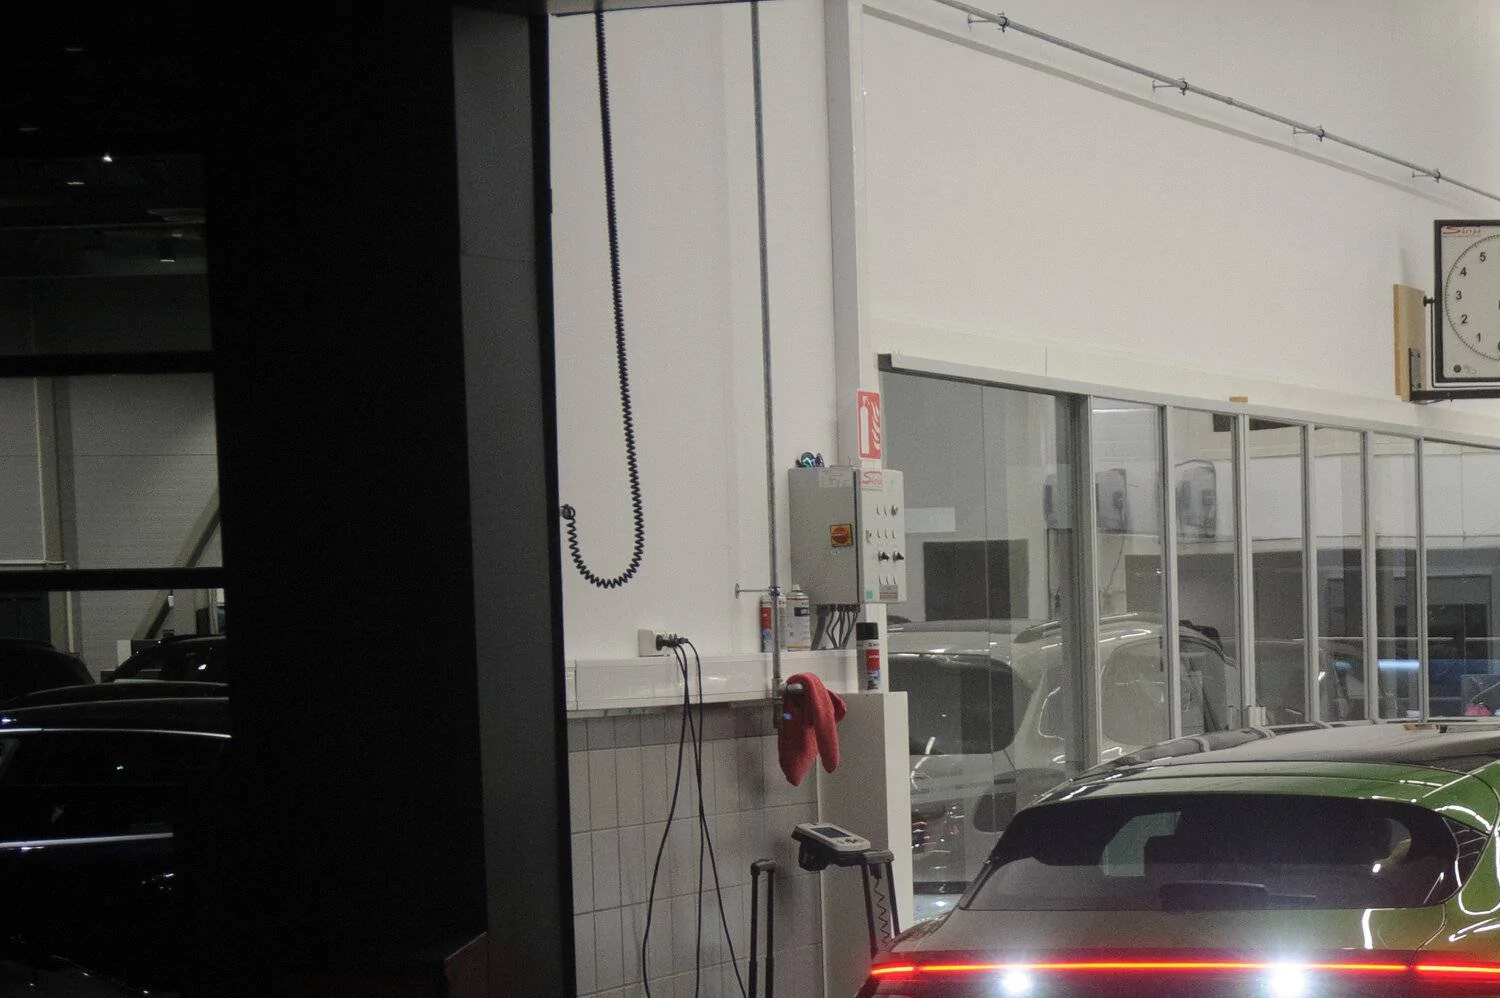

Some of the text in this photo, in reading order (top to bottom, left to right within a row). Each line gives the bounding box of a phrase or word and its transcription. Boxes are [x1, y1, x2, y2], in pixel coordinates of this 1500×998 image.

[1479, 252, 1487, 263] 5
[1460, 266, 1468, 277] 4
[1455, 290, 1463, 301] 3
[1461, 314, 1469, 325] 2
[1475, 332, 1482, 343] 1
